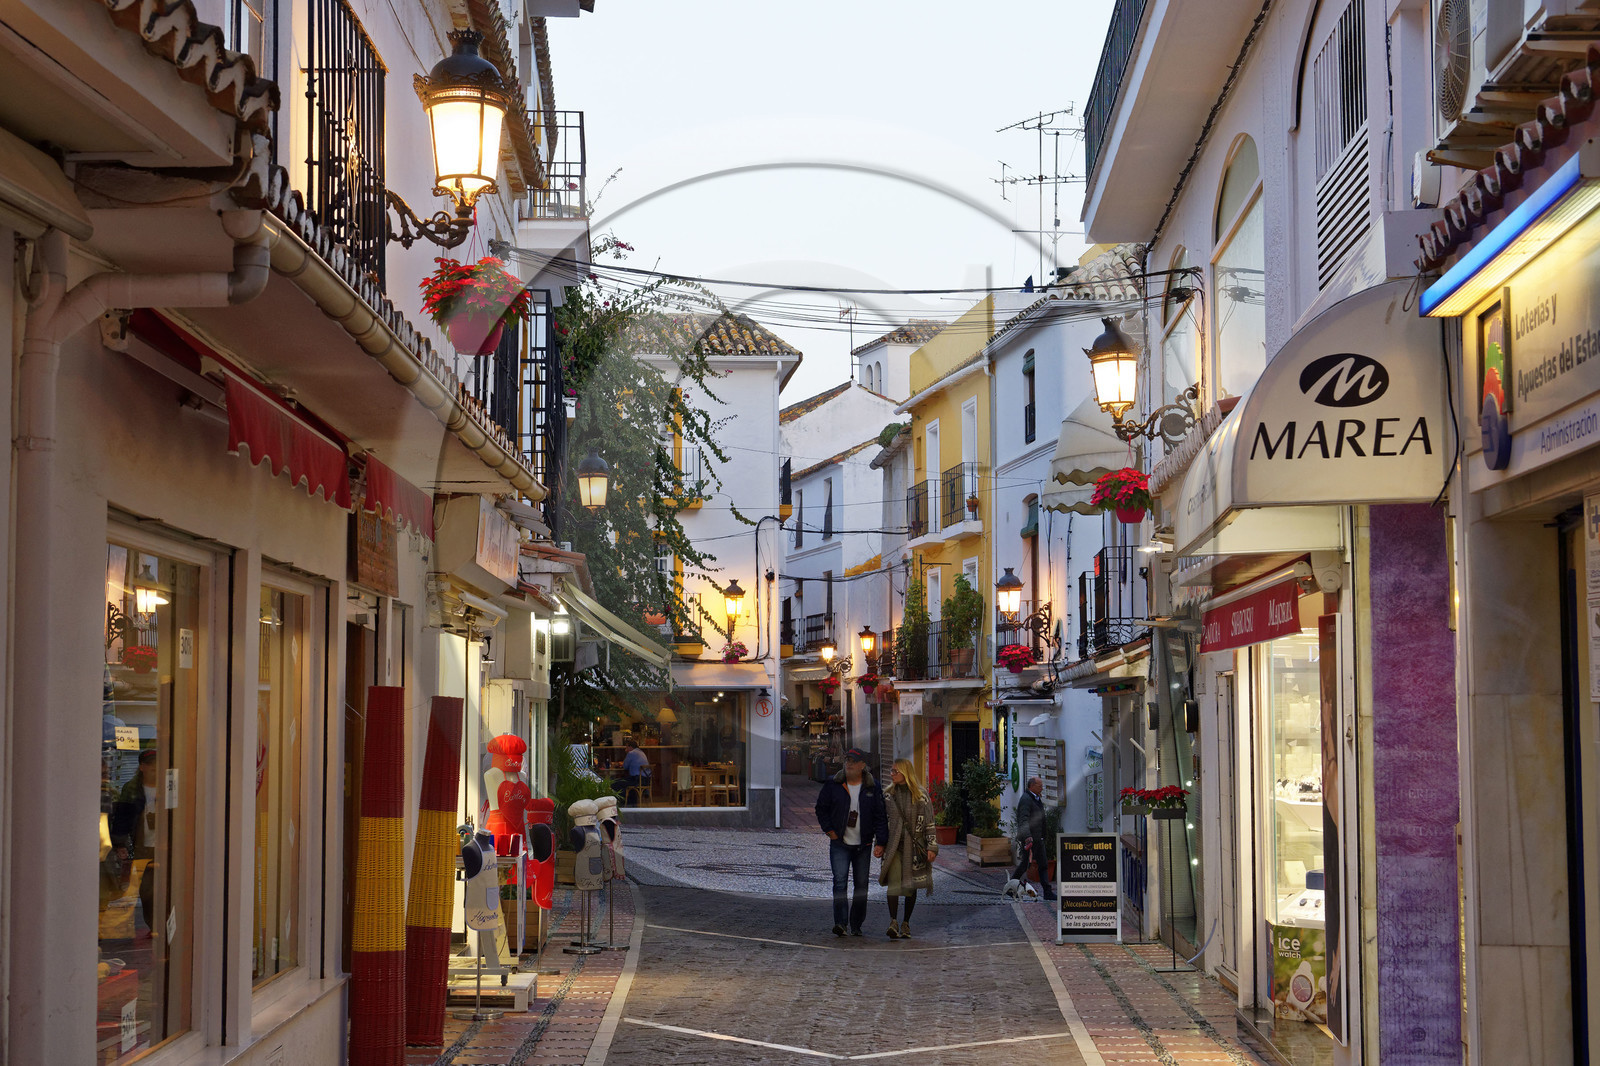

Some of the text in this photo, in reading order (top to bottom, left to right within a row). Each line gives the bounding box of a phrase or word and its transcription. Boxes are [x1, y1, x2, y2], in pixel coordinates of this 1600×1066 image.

[1515, 293, 1557, 341] Loterías y
[1517, 328, 1600, 403] Apuestas del Esta
[1250, 416, 1433, 461] MAREA
[1540, 408, 1598, 455] Administración
[1064, 842, 1084, 850] Time
[1072, 854, 1105, 862] COMPRO
[1070, 870, 1108, 879] EMPEÑOS
[1277, 932, 1301, 951] ice
[1278, 951, 1301, 959] watch
